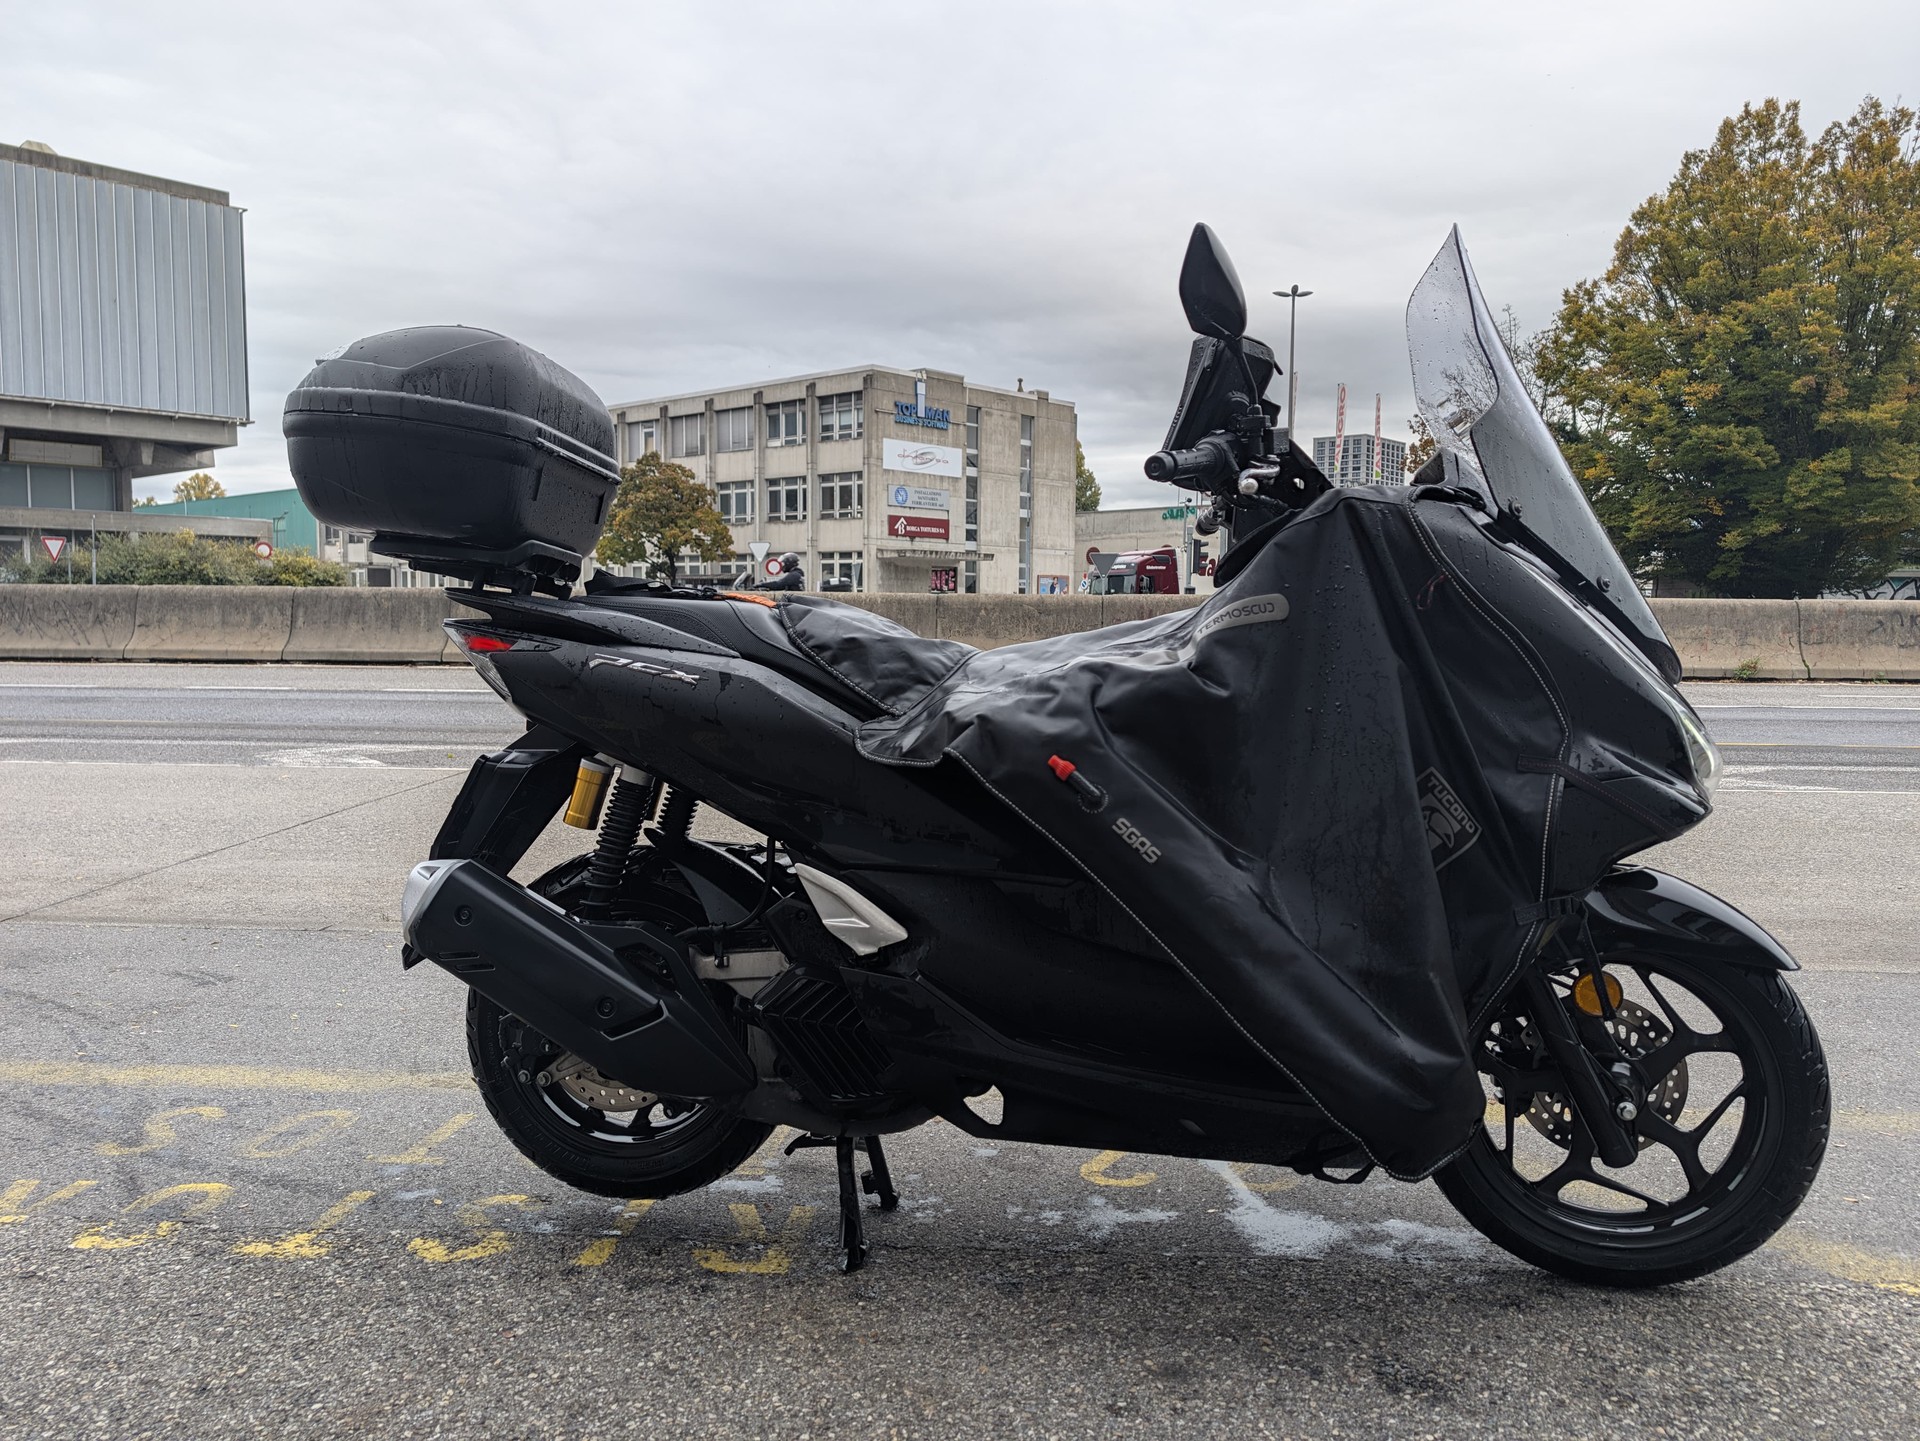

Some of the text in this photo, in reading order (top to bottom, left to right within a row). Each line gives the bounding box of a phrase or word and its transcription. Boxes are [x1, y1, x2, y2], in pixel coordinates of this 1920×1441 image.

[894, 401, 951, 422] TOP MAN
[1334, 386, 1346, 464] ALIGRO
[1197, 602, 1275, 635] TERMOSCUD
[588, 652, 701, 686] PCX
[1427, 776, 1475, 834] TUCANO
[1112, 817, 1162, 864] SGAS
